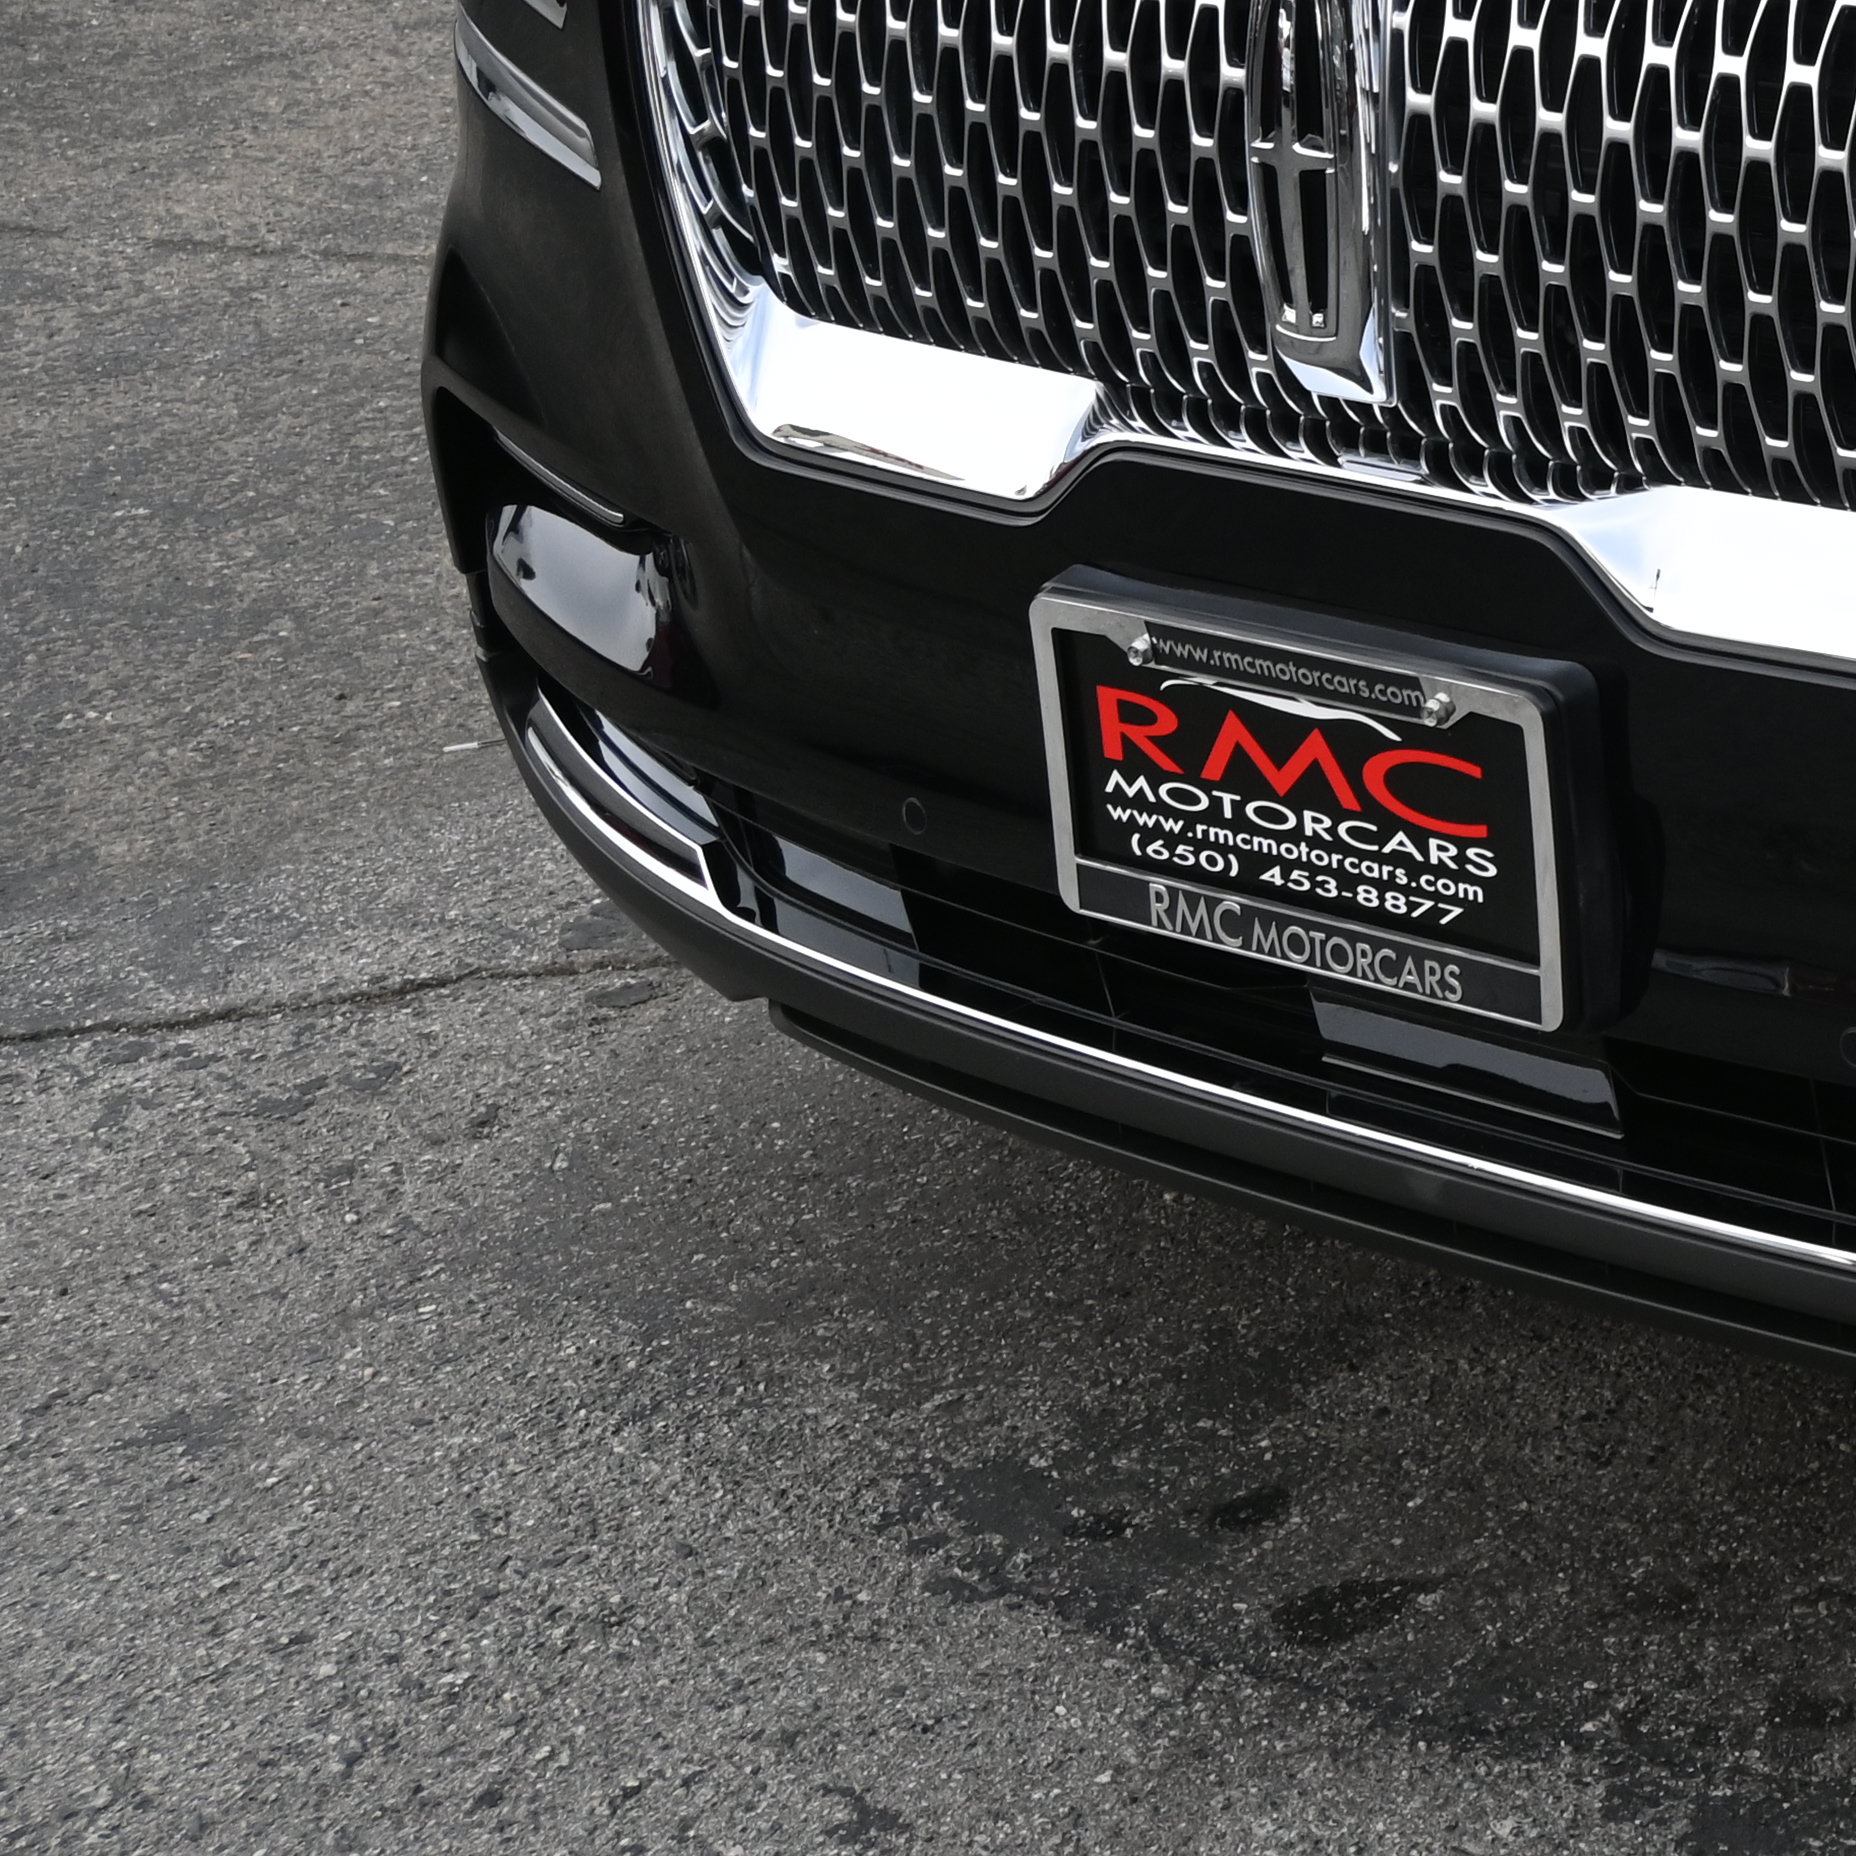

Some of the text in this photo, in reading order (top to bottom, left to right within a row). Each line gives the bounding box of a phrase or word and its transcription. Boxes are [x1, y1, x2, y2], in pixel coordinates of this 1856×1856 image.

[1156, 637, 1425, 708] www.rmcmotorcars.com
[1096, 685, 1488, 838] RMC
[1105, 769, 1498, 877] MOTORCARS
[1106, 803, 1484, 903] www.rmcmotorcars.com
[1131, 833, 1465, 925] (650) 453-8877
[1149, 883, 1463, 1002] RMC MOTORCARS
